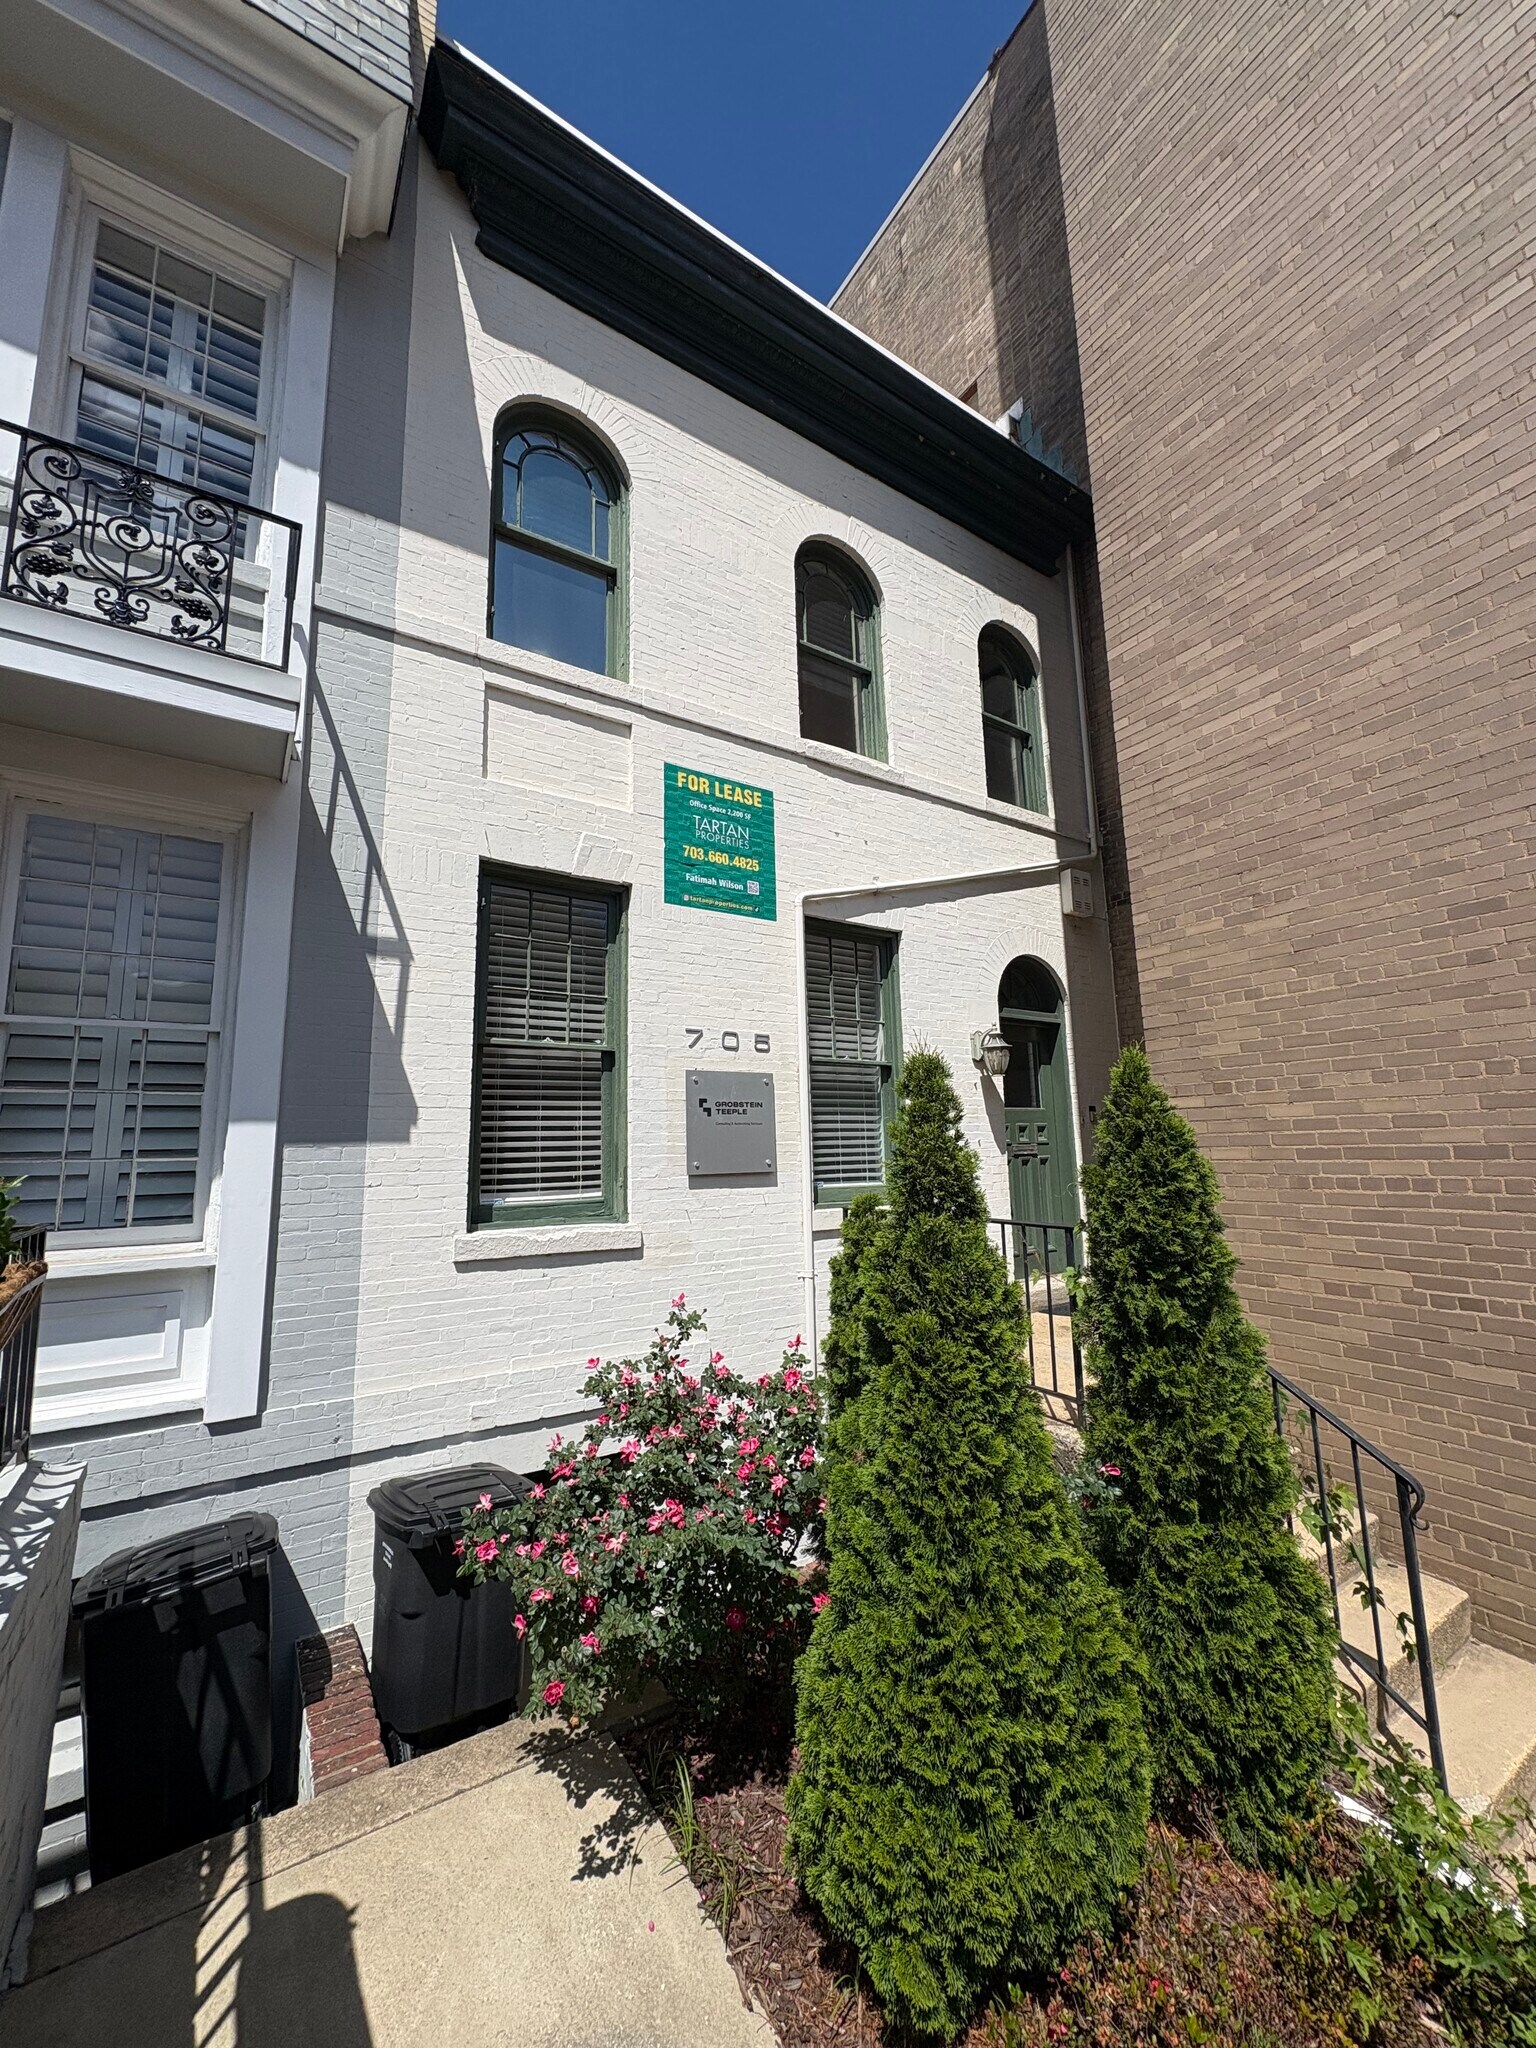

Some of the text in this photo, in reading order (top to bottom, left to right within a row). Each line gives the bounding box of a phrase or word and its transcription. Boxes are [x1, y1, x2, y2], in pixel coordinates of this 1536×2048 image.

[677, 771, 763, 808] FOR LEASE
[690, 800, 707, 809] Office
[708, 804, 726, 814] Space
[693, 815, 750, 840] TARTAN
[696, 830, 750, 850] PROPERTIES
[682, 844, 760, 872] 703.660.4825
[685, 873, 744, 891] Fatimah Wilson
